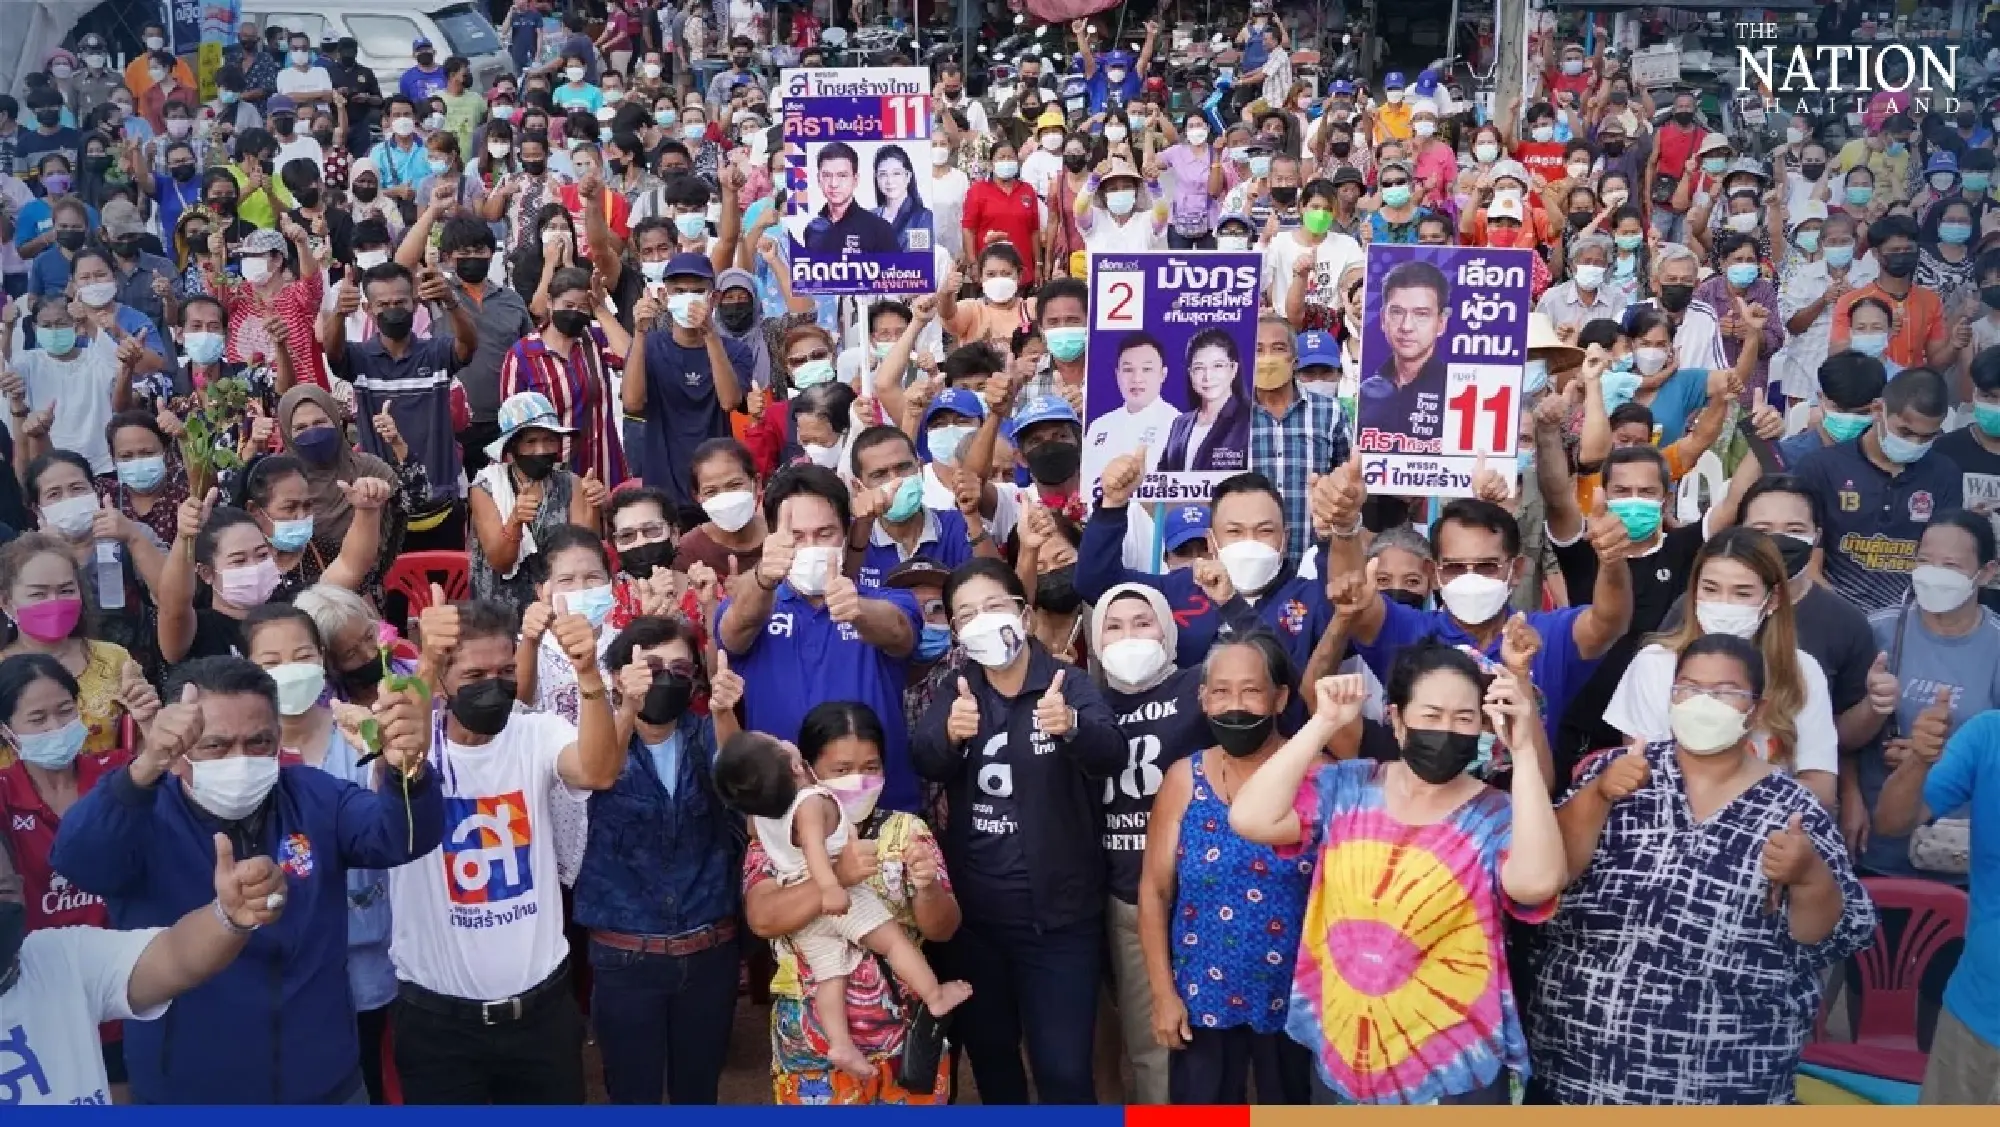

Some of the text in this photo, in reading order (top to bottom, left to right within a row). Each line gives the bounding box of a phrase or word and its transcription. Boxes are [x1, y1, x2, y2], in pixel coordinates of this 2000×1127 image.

[816, 77, 921, 95] ไทยสร้างไทย
[888, 97, 926, 138] 11
[792, 254, 880, 281] คิดต่าง
[1157, 257, 1258, 289] มังกร
[1457, 258, 1525, 288] เลือก
[1107, 282, 1134, 321] 2
[1461, 293, 1517, 330] ผู้ว่า
[1451, 334, 1520, 357] กทม.
[1449, 384, 1513, 453] 11
[1144, 474, 1168, 484] รรค
[1392, 466, 1472, 488] ไทยสร้าง
[1967, 477, 2000, 498] WA
[1838, 490, 1861, 512] 13
